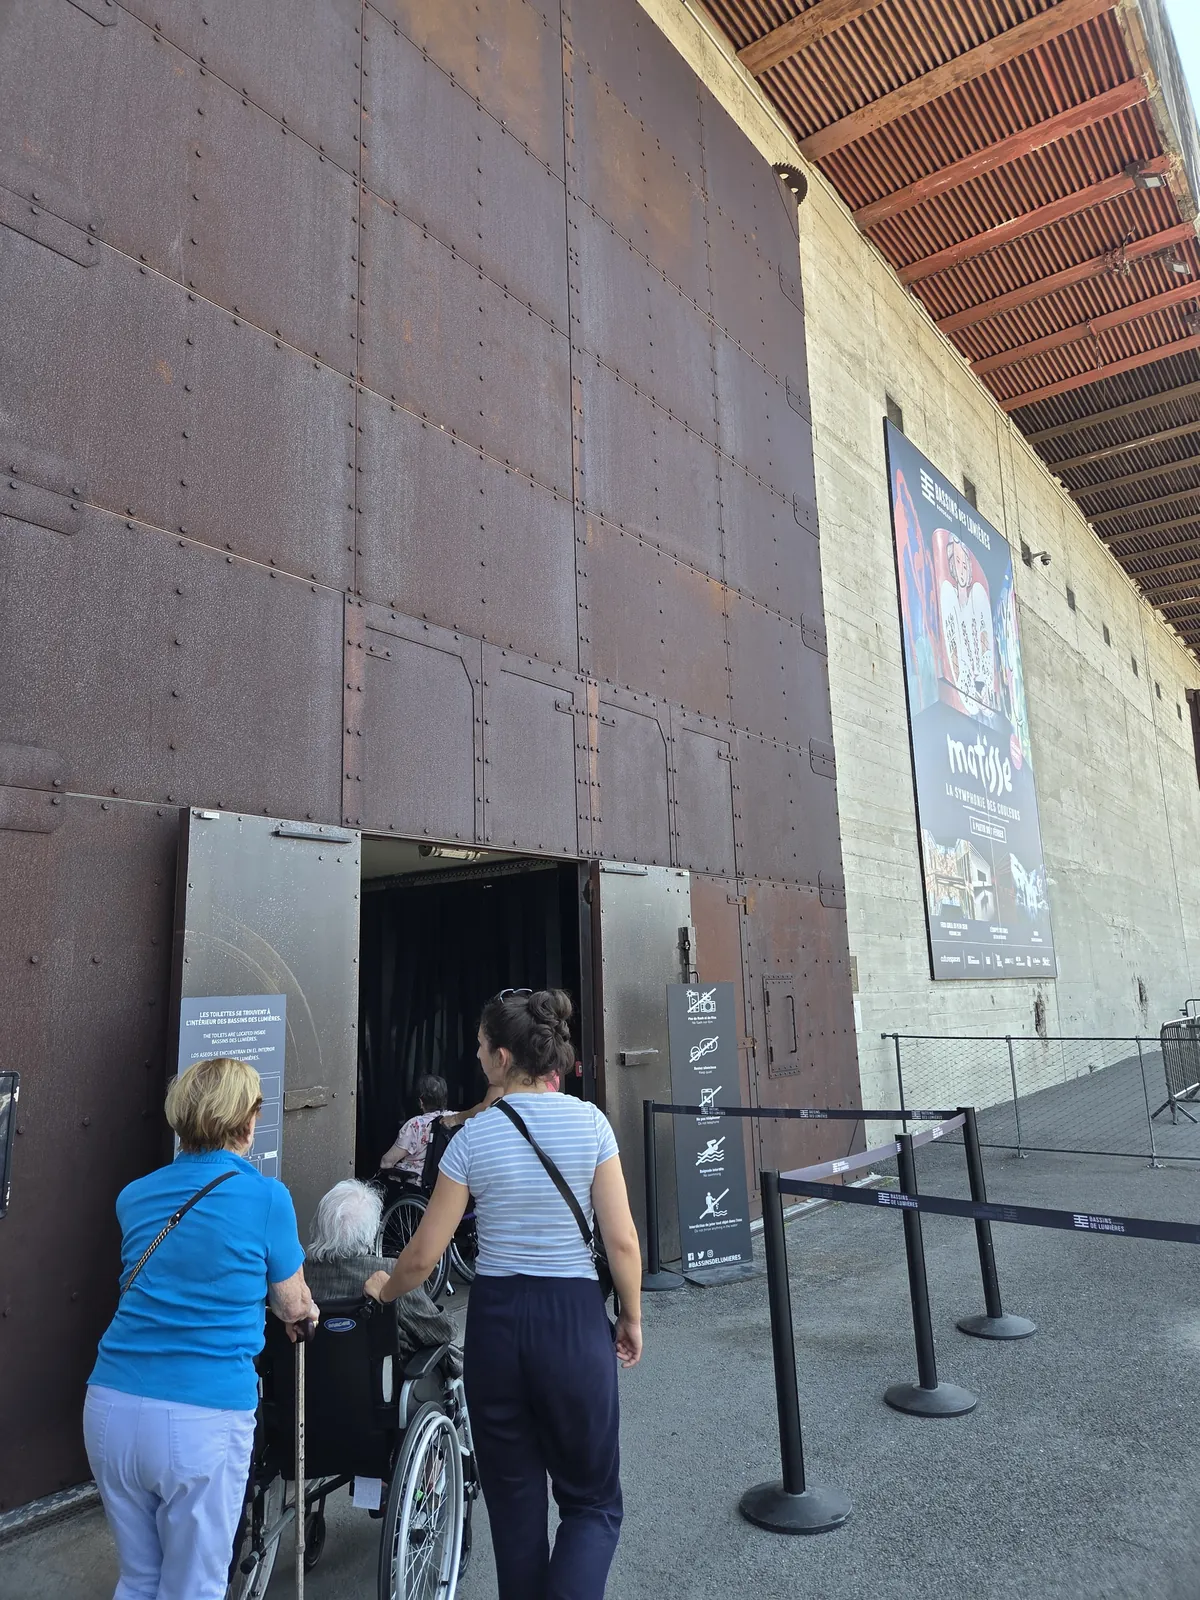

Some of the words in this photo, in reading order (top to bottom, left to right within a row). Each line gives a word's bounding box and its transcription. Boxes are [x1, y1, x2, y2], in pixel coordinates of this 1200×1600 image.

[934, 482, 959, 520] BASSINS
[946, 733, 1013, 797] matisse
[945, 782, 954, 797] LA
[954, 785, 986, 809] SYMPHONIE
[986, 798, 997, 813] DES
[997, 802, 1021, 821] COULEURS
[267, 1007, 271, 1015] À
[186, 1018, 217, 1026] L'INTÉRIEUR
[890, 1193, 909, 1201] BASSINS
[1089, 1215, 1112, 1224] BASSINS
